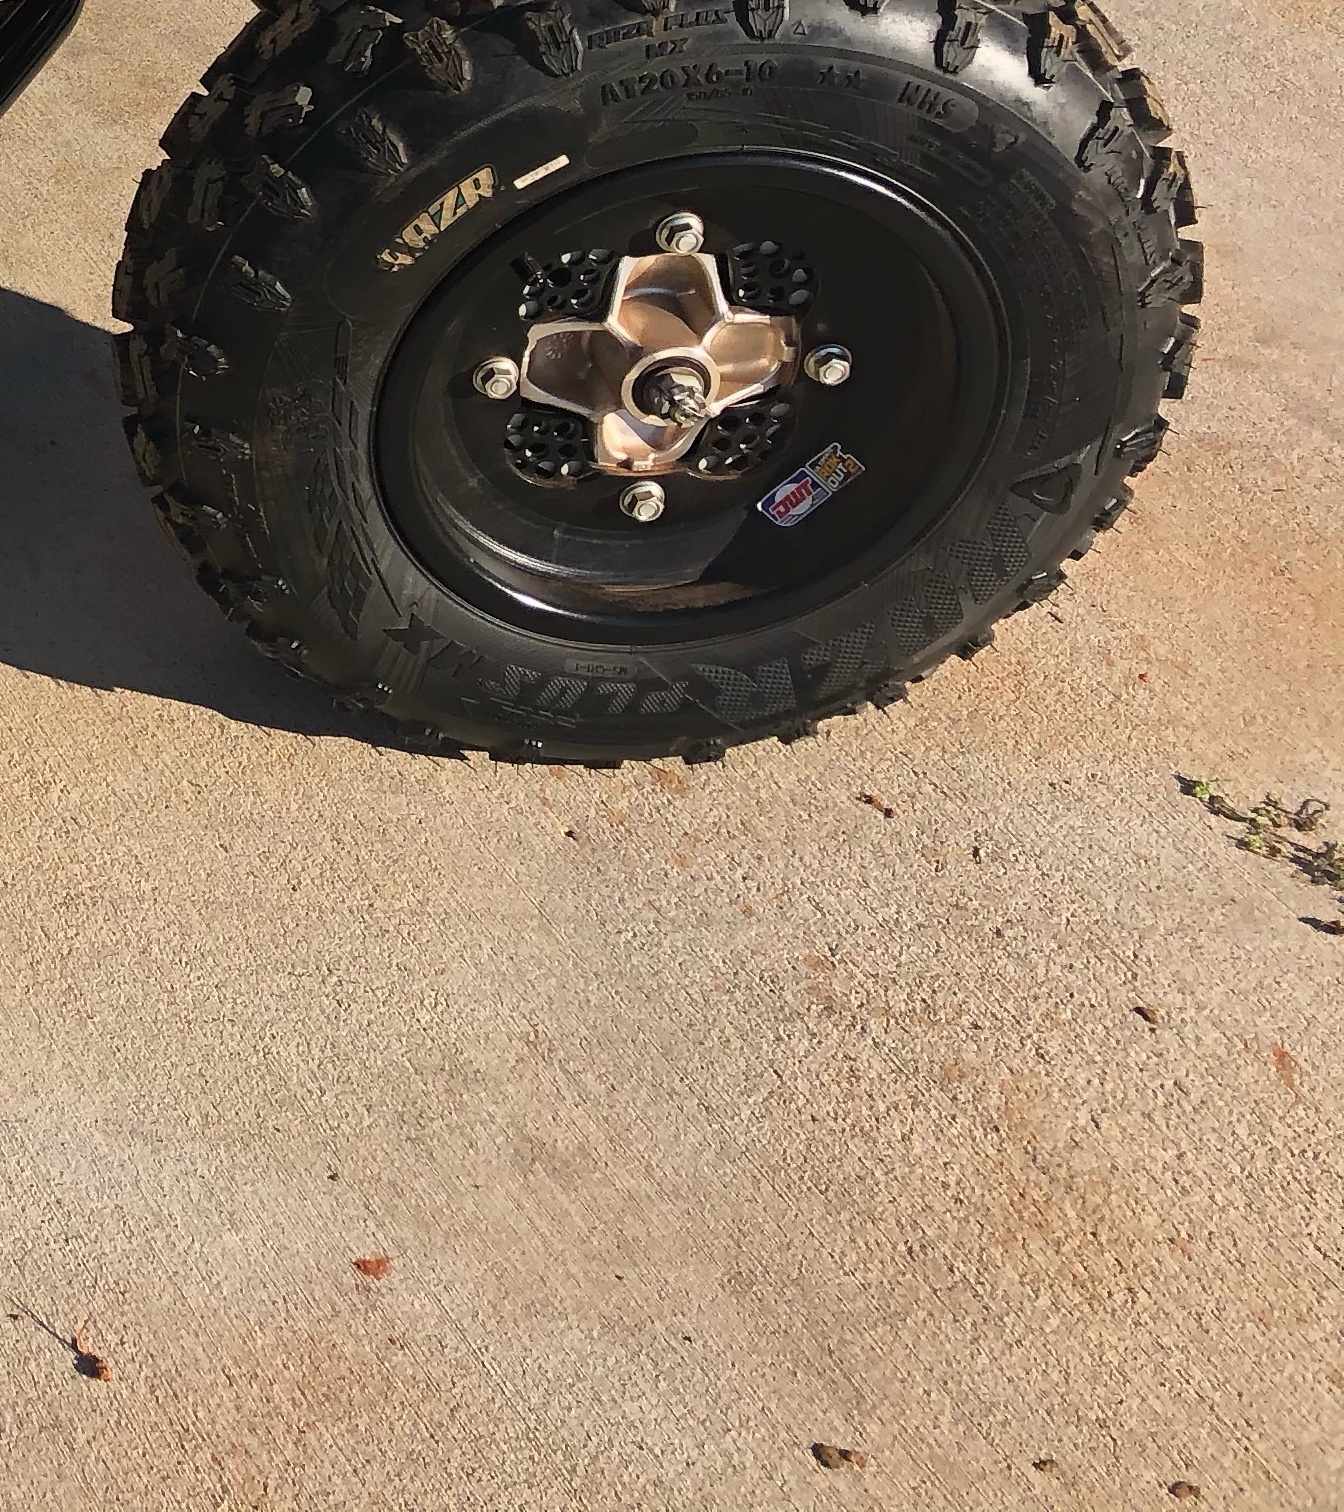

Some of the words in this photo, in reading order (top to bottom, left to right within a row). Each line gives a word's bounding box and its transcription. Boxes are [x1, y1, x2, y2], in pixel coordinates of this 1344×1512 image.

[601, 58, 779, 107] AT20X6-10
[896, 81, 957, 120] NHS
[827, 462, 848, 489] OUT
